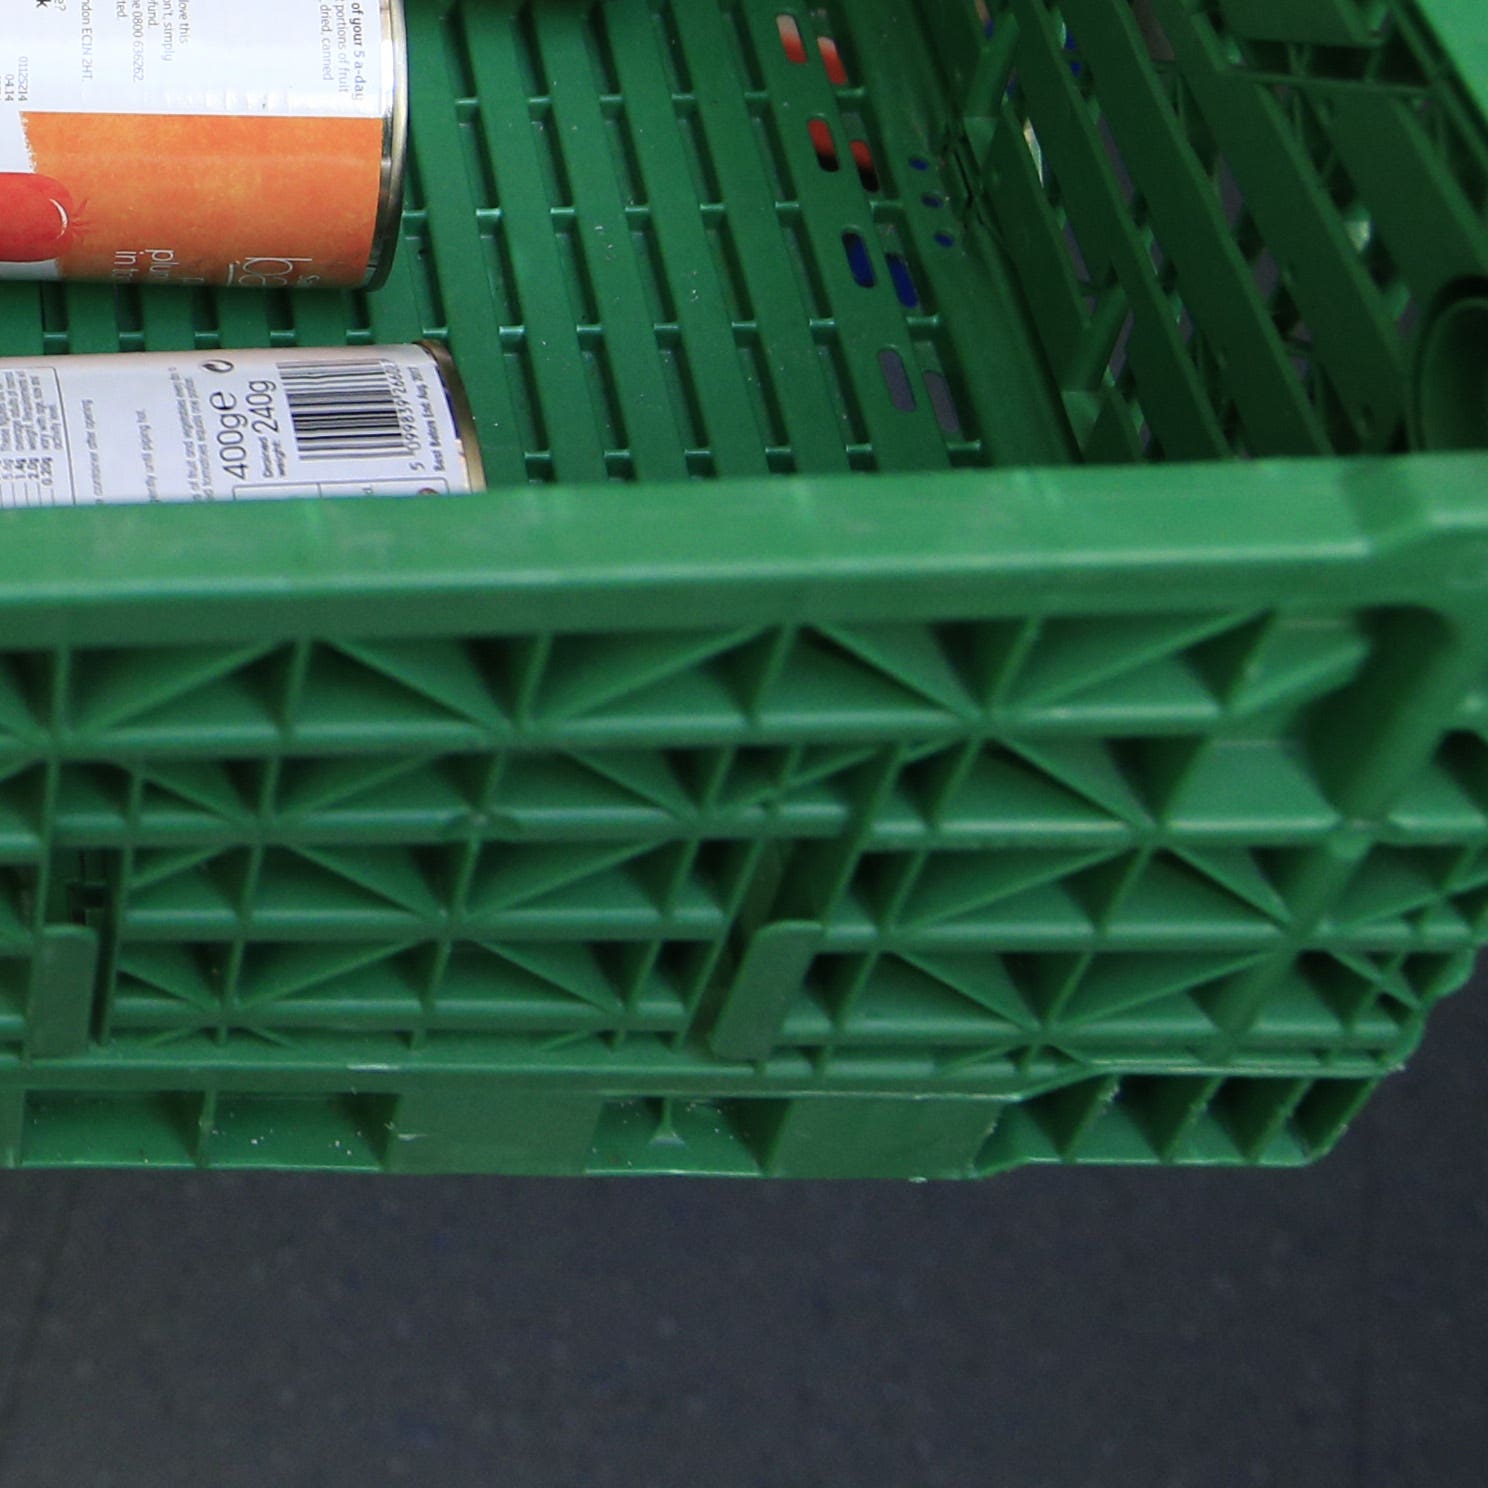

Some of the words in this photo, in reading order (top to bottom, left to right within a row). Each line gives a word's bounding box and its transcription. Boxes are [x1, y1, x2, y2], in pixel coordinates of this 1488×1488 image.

[132, 11, 143, 37] 0800
[320, 5, 332, 34] dried,
[334, 5, 348, 49] portions
[350, 18, 363, 46] your
[160, 23, 175, 61] simply
[321, 38, 333, 80] canned
[351, 62, 364, 100] a-day
[246, 380, 279, 433] 240g
[217, 413, 248, 480] 400g
[426, 421, 440, 447] Before
[259, 437, 274, 477] Drained
